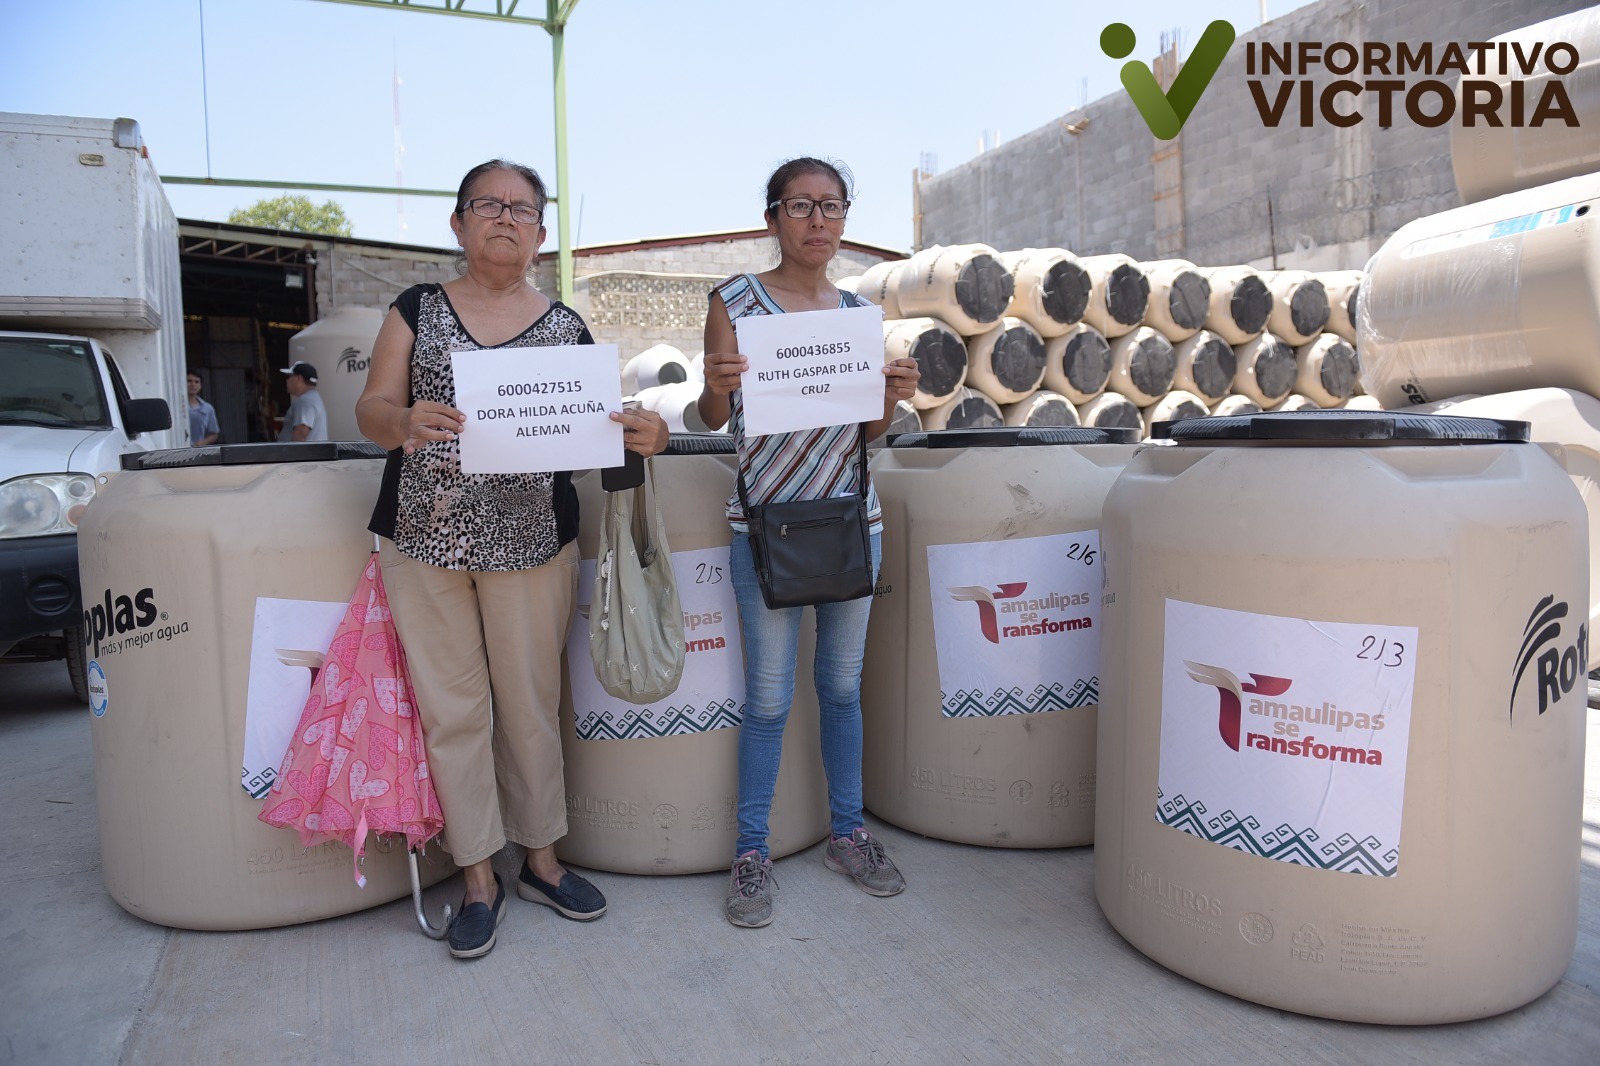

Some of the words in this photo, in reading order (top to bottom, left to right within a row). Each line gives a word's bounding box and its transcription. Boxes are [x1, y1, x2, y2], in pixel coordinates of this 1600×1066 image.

[776, 342, 850, 360] 6000436855
[758, 370, 790, 382] RUTH
[793, 364, 837, 379] GASPAR
[840, 363, 854, 373] DE
[857, 361, 870, 372] LA
[497, 380, 582, 397] 6000427515
[801, 383, 831, 395] CRUZ
[477, 407, 516, 421] DORA
[519, 405, 557, 418] HILDA
[560, 400, 605, 415] ACUÑA
[516, 424, 571, 437] ALEMAN
[1020, 610, 1038, 624] se
[125, 631, 154, 649] mejor
[157, 621, 189, 642] agua
[1273, 720, 1300, 738] se
[1156, 876, 1222, 918] LITROS
[1290, 947, 1326, 963] PEAD
